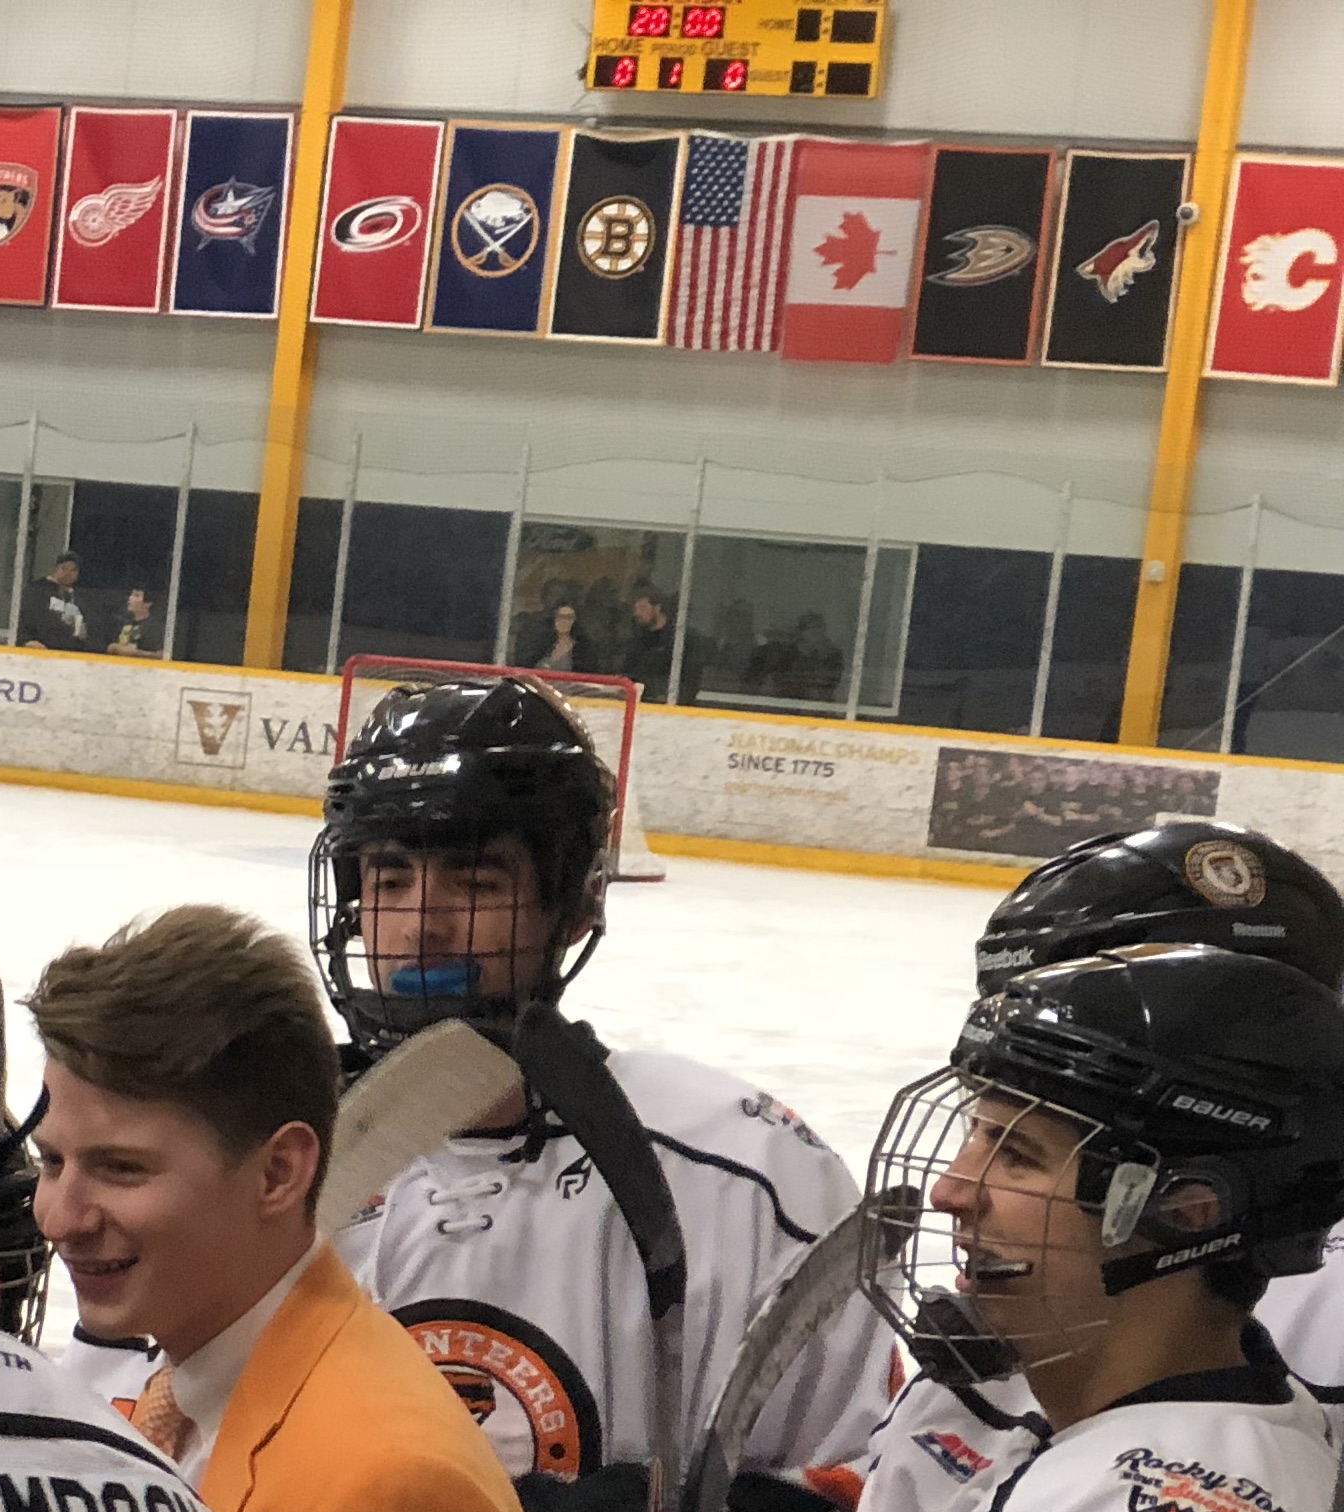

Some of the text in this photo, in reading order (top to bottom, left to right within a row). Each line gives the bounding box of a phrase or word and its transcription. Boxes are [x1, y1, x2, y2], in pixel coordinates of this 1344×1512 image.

[724, 60, 746, 90] 0
[728, 753, 835, 777] SINCE 1775
[1113, 1447, 1228, 1490] Rocky
